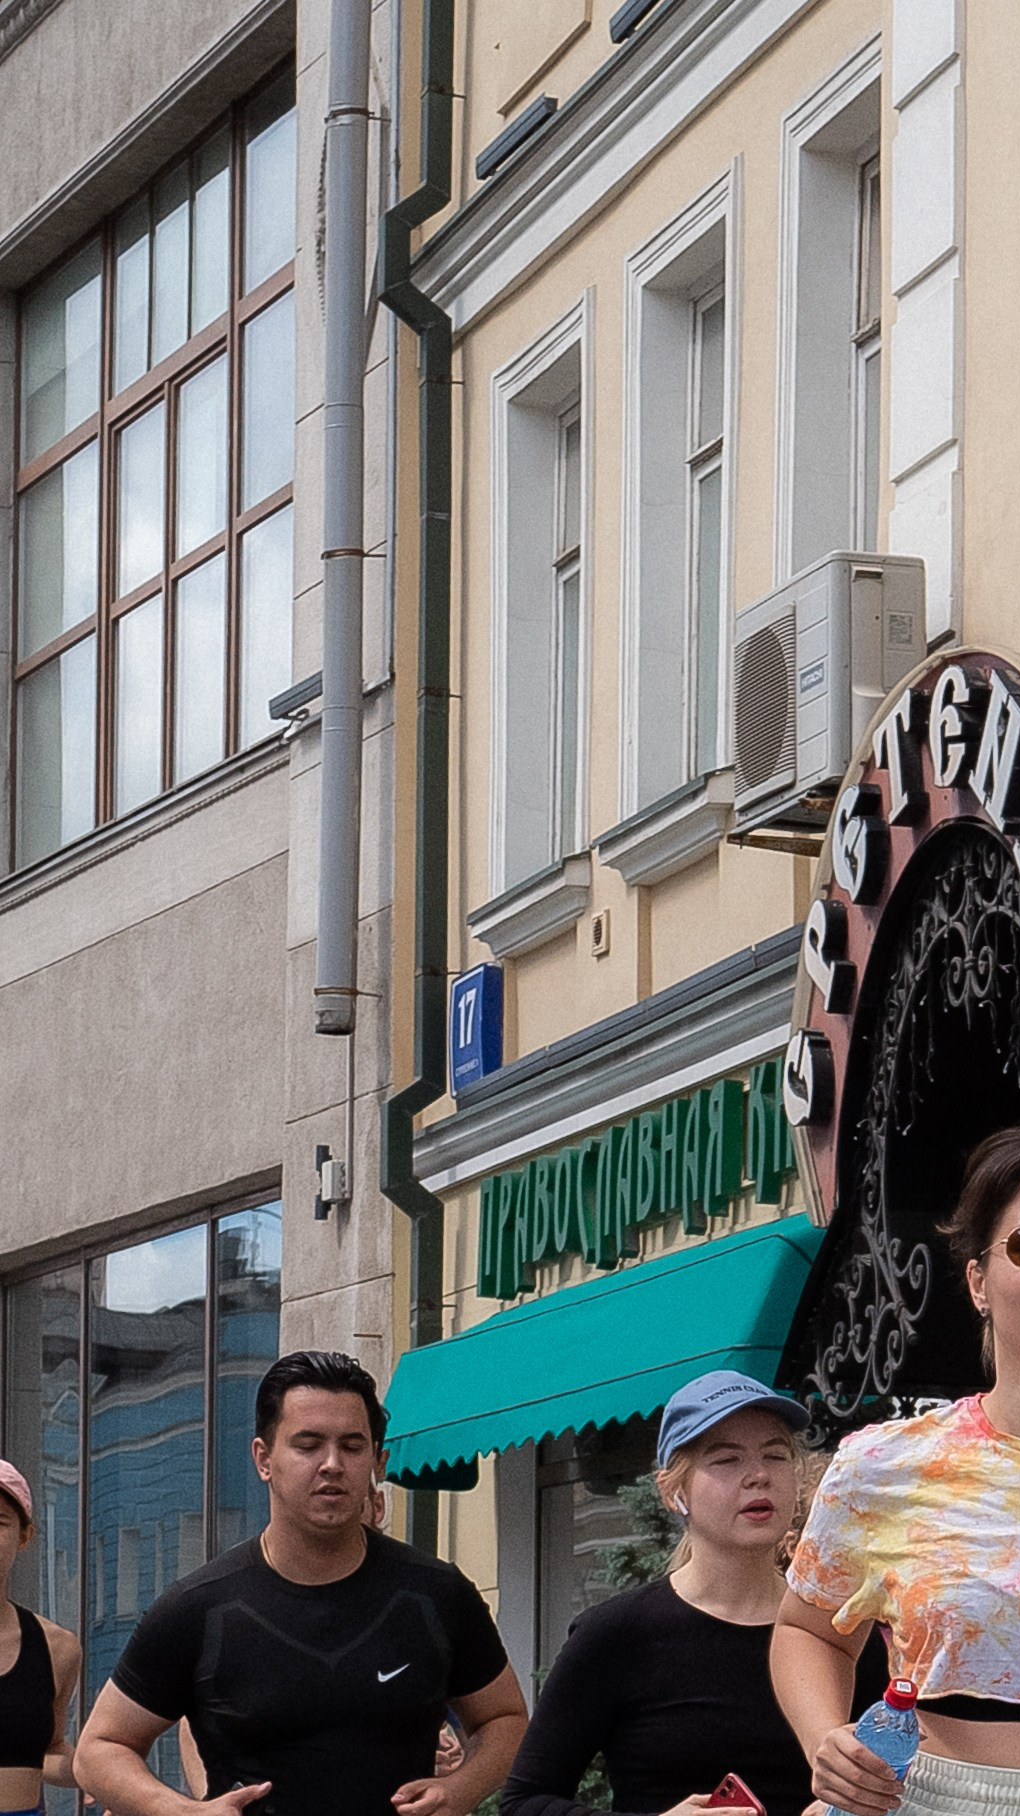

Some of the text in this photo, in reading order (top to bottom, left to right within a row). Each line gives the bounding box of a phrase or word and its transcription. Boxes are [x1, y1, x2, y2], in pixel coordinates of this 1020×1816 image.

[458, 987, 477, 1049] 17
[477, 1079, 738, 1299] ПРАВОСЛАВНАЯ
[701, 1385, 743, 1403] TENNIS
